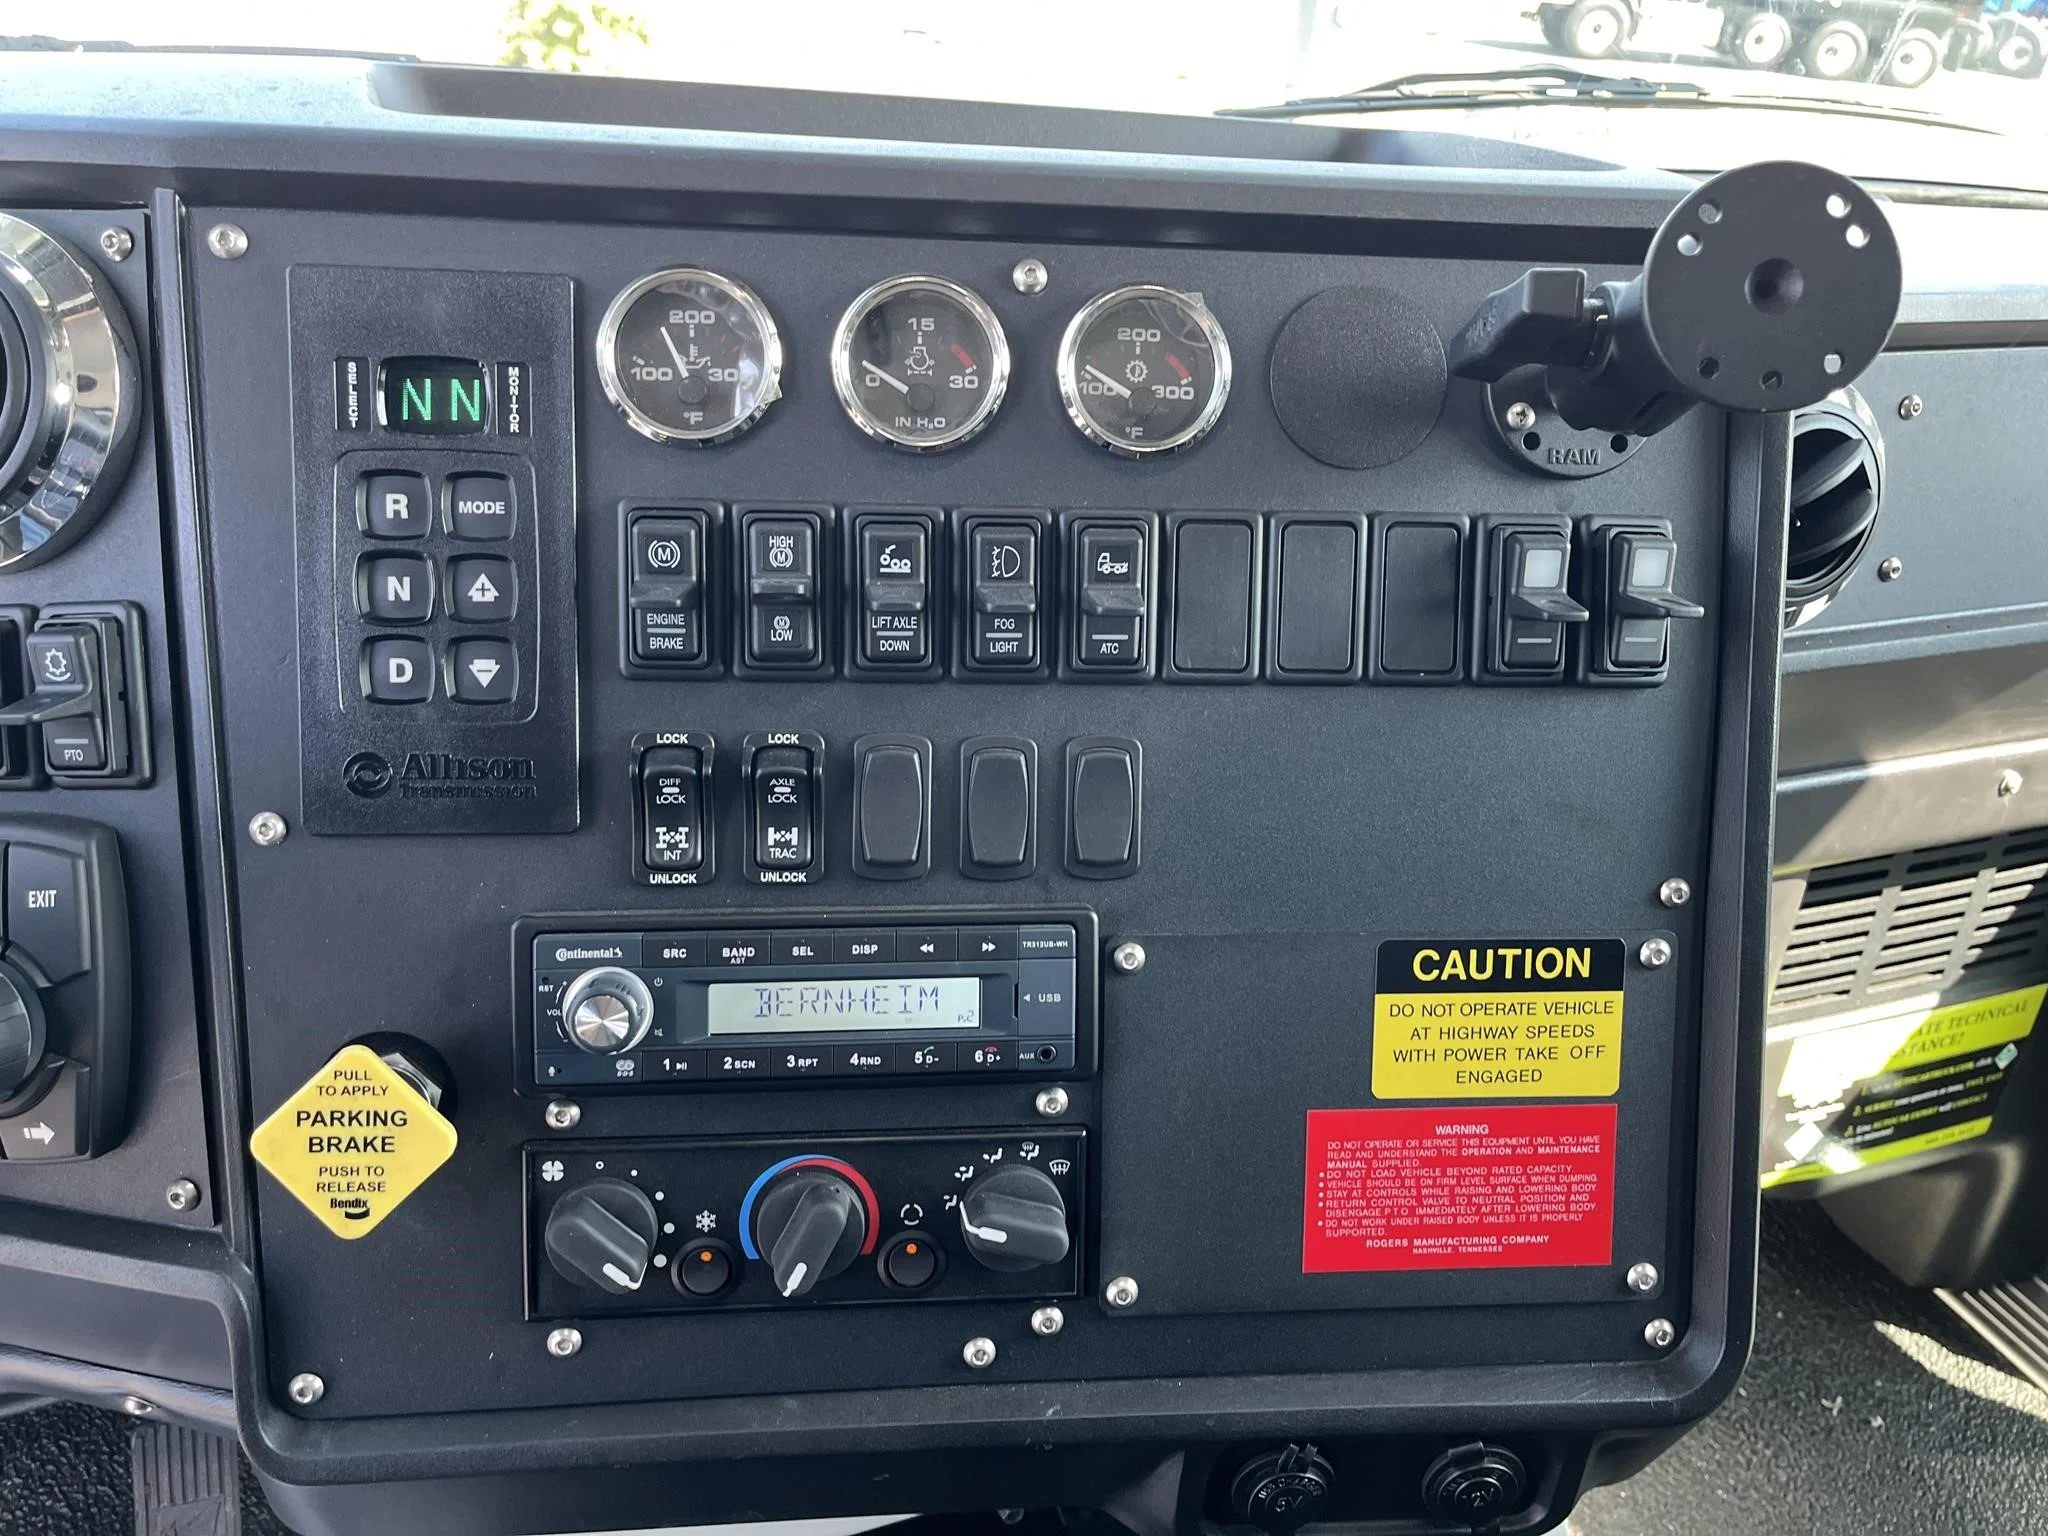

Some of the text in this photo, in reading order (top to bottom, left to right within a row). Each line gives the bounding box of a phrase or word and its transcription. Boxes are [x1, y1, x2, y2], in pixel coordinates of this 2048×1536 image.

[669, 310, 715, 324] 200
[907, 317, 935, 331] 15
[1117, 327, 1161, 342] 200
[630, 367, 673, 381] 100
[865, 373, 881, 387] 0
[949, 374, 979, 389] 30
[347, 361, 359, 428] SELECT
[1151, 385, 1195, 400] 300
[402, 378, 480, 422] N N
[507, 366, 520, 433] MONITOR
[895, 416, 912, 427] IN
[1548, 447, 1600, 465] RAM
[384, 493, 409, 519] R
[458, 501, 506, 515] MODE
[769, 535, 794, 548] HIGH
[387, 575, 411, 601] N
[646, 613, 685, 625] ENGINE
[871, 616, 917, 630] LIFT AXLE
[994, 618, 1015, 630] FOG
[770, 629, 793, 641] LOW
[649, 637, 684, 649] BRAKE
[879, 640, 910, 652] DOWN
[990, 641, 1018, 653] LIGHT
[1100, 643, 1119, 655] ATC
[388, 657, 414, 684] D
[656, 733, 688, 744] LOCK
[768, 733, 799, 744] LOCK
[64, 749, 84, 762] PTO
[659, 778, 681, 786] DIFF
[769, 778, 795, 786] AXLE
[656, 794, 686, 804] LOCK
[768, 794, 797, 804] LOCK
[664, 850, 682, 861] INT
[769, 848, 797, 859] TRAC
[649, 873, 697, 885] UNLOCK
[760, 872, 807, 883] UNLOCK
[28, 890, 57, 909] EXIT
[555, 947, 613, 962] Continental
[663, 948, 687, 959] SRC
[722, 947, 756, 958] BAND
[791, 946, 814, 957] SEL
[851, 944, 878, 955] DISP
[1412, 947, 1591, 982] CAUTION
[538, 984, 554, 993] RST
[753, 985, 939, 1018] BERNHEIM
[1038, 993, 1061, 1003] USB
[546, 1008, 562, 1017] VOL
[1389, 1001, 1614, 1018] DO NOT OPERATE VEHICLE
[1410, 1024, 1595, 1041] AT HIGHWAY SPEEDS
[860, 1055, 882, 1065] RND
[1019, 1052, 1035, 1061] AUX
[1393, 1045, 1606, 1063] WITH POWER TAKE OFF
[662, 1058, 670, 1071] 1
[734, 1060, 756, 1069] SCN
[798, 1058, 818, 1067] RPT
[333, 1070, 372, 1081] PULL
[1456, 1069, 1543, 1084] ENGAGED
[316, 1085, 389, 1096] TO APPLY
[296, 1110, 408, 1128] PARKING
[1435, 1124, 1489, 1136] WARNING
[308, 1136, 396, 1153] BRAKE
[1327, 1135, 1600, 1150] DO NOT OPERATE OR SERVICE THIS EQUIPMENT UNTIL YOU HAVE
[1327, 1145, 1600, 1159] READ AND UNDERSTAND THE OPERATION AND MAINTENANCE
[1327, 1160, 1367, 1169] MANUAL
[318, 1166, 385, 1177] PUSH TO
[1326, 1166, 1522, 1179] DO NOT LOAD VEHICLE BEYOND RATED
[316, 1181, 387, 1193] RELEASE
[1326, 1179, 1362, 1188] VEHICLE
[1366, 1178, 1401, 1187] SHOULD
[1404, 1178, 1416, 1187] BE
[1420, 1178, 1433, 1186] ON
[1436, 1177, 1457, 1186] FIRM
[1460, 1176, 1486, 1185] LEVEL
[1489, 1175, 1527, 1184] SURFACE
[1531, 1174, 1555, 1183] WHEN
[1326, 1184, 1567, 1198] STAY AT CONTROLS WHILE RAISING AND LOWERING
[330, 1197, 368, 1209] Bendix
[1326, 1193, 1589, 1208] RETURN CONTROL VALVE TO NEUTRAL POSITION AND
[1325, 1203, 1565, 1218] DISENGAGE IMMEDIATELY AFTER LOWERING
[1325, 1213, 1584, 1227] DO NOT WORK UNDER RAISED BODY UNLESS IT IS PROPERLY
[1366, 1235, 1549, 1248] ROGERS MANUFACTURING COMPANY
[1458, 1245, 1503, 1254] TENNESSEE
